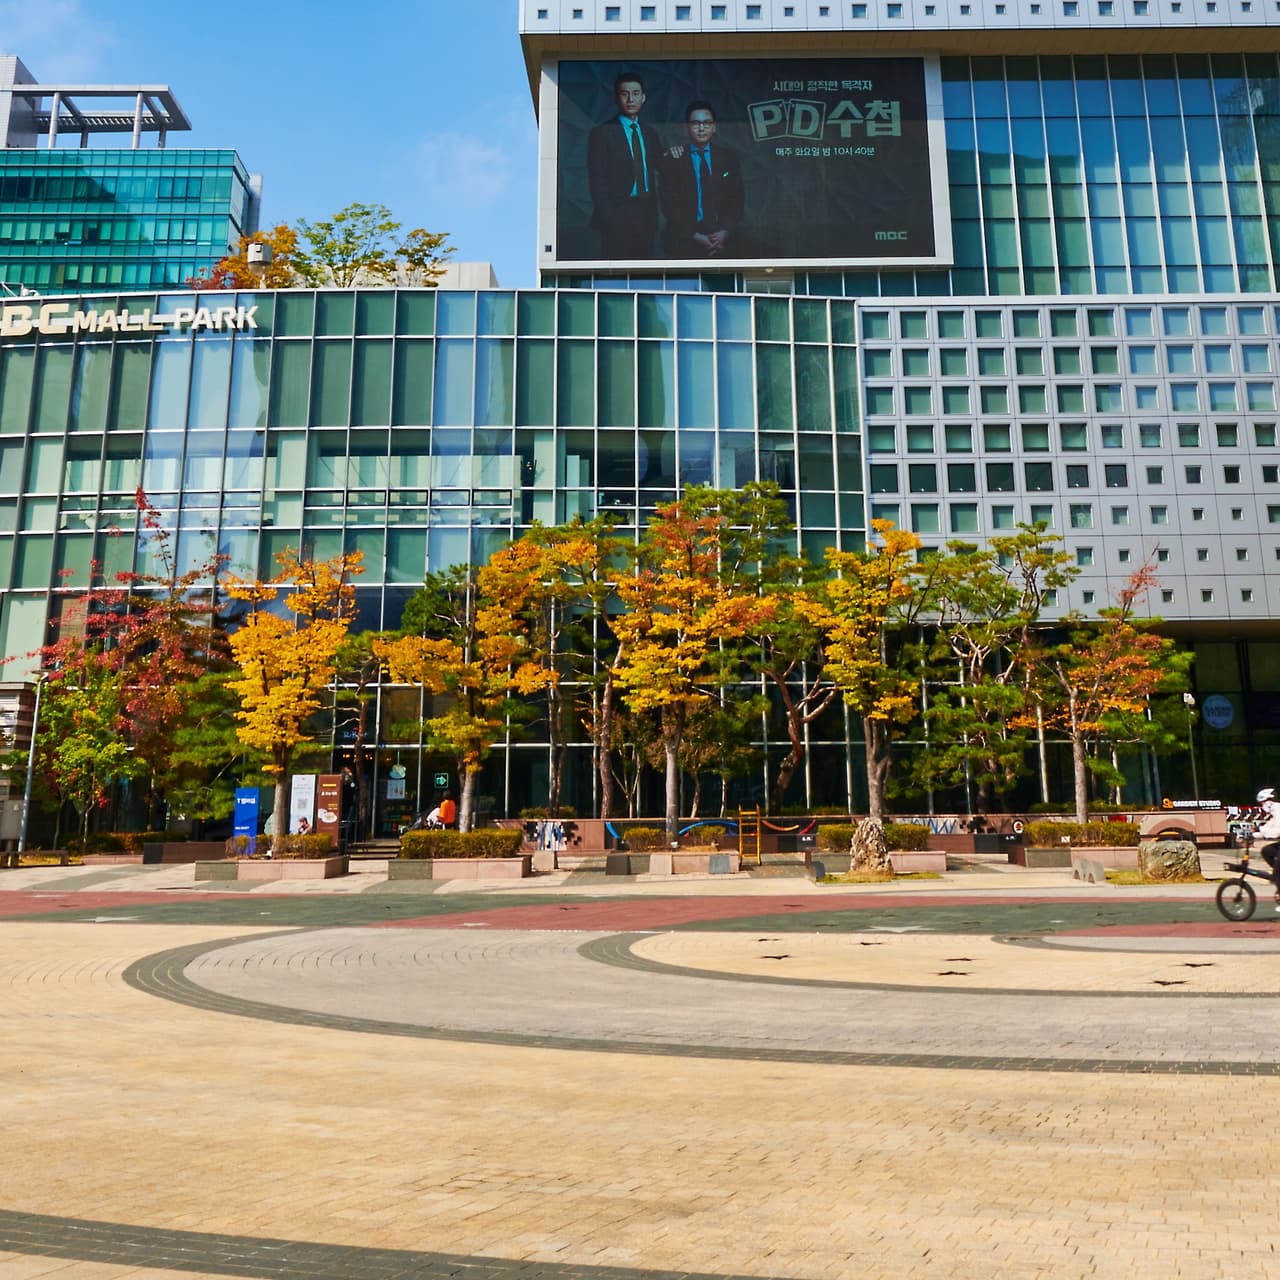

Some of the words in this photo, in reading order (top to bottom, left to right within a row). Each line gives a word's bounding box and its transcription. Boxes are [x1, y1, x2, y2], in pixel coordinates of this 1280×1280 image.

[772, 80, 804, 93] 시대의
[807, 80, 839, 92] 정직한
[841, 79, 873, 92] 목격자
[752, 99, 902, 138] PD수첩
[834, 146, 853, 157] 10시
[71, 307, 164, 333] MALL
[174, 304, 260, 330] PARK
